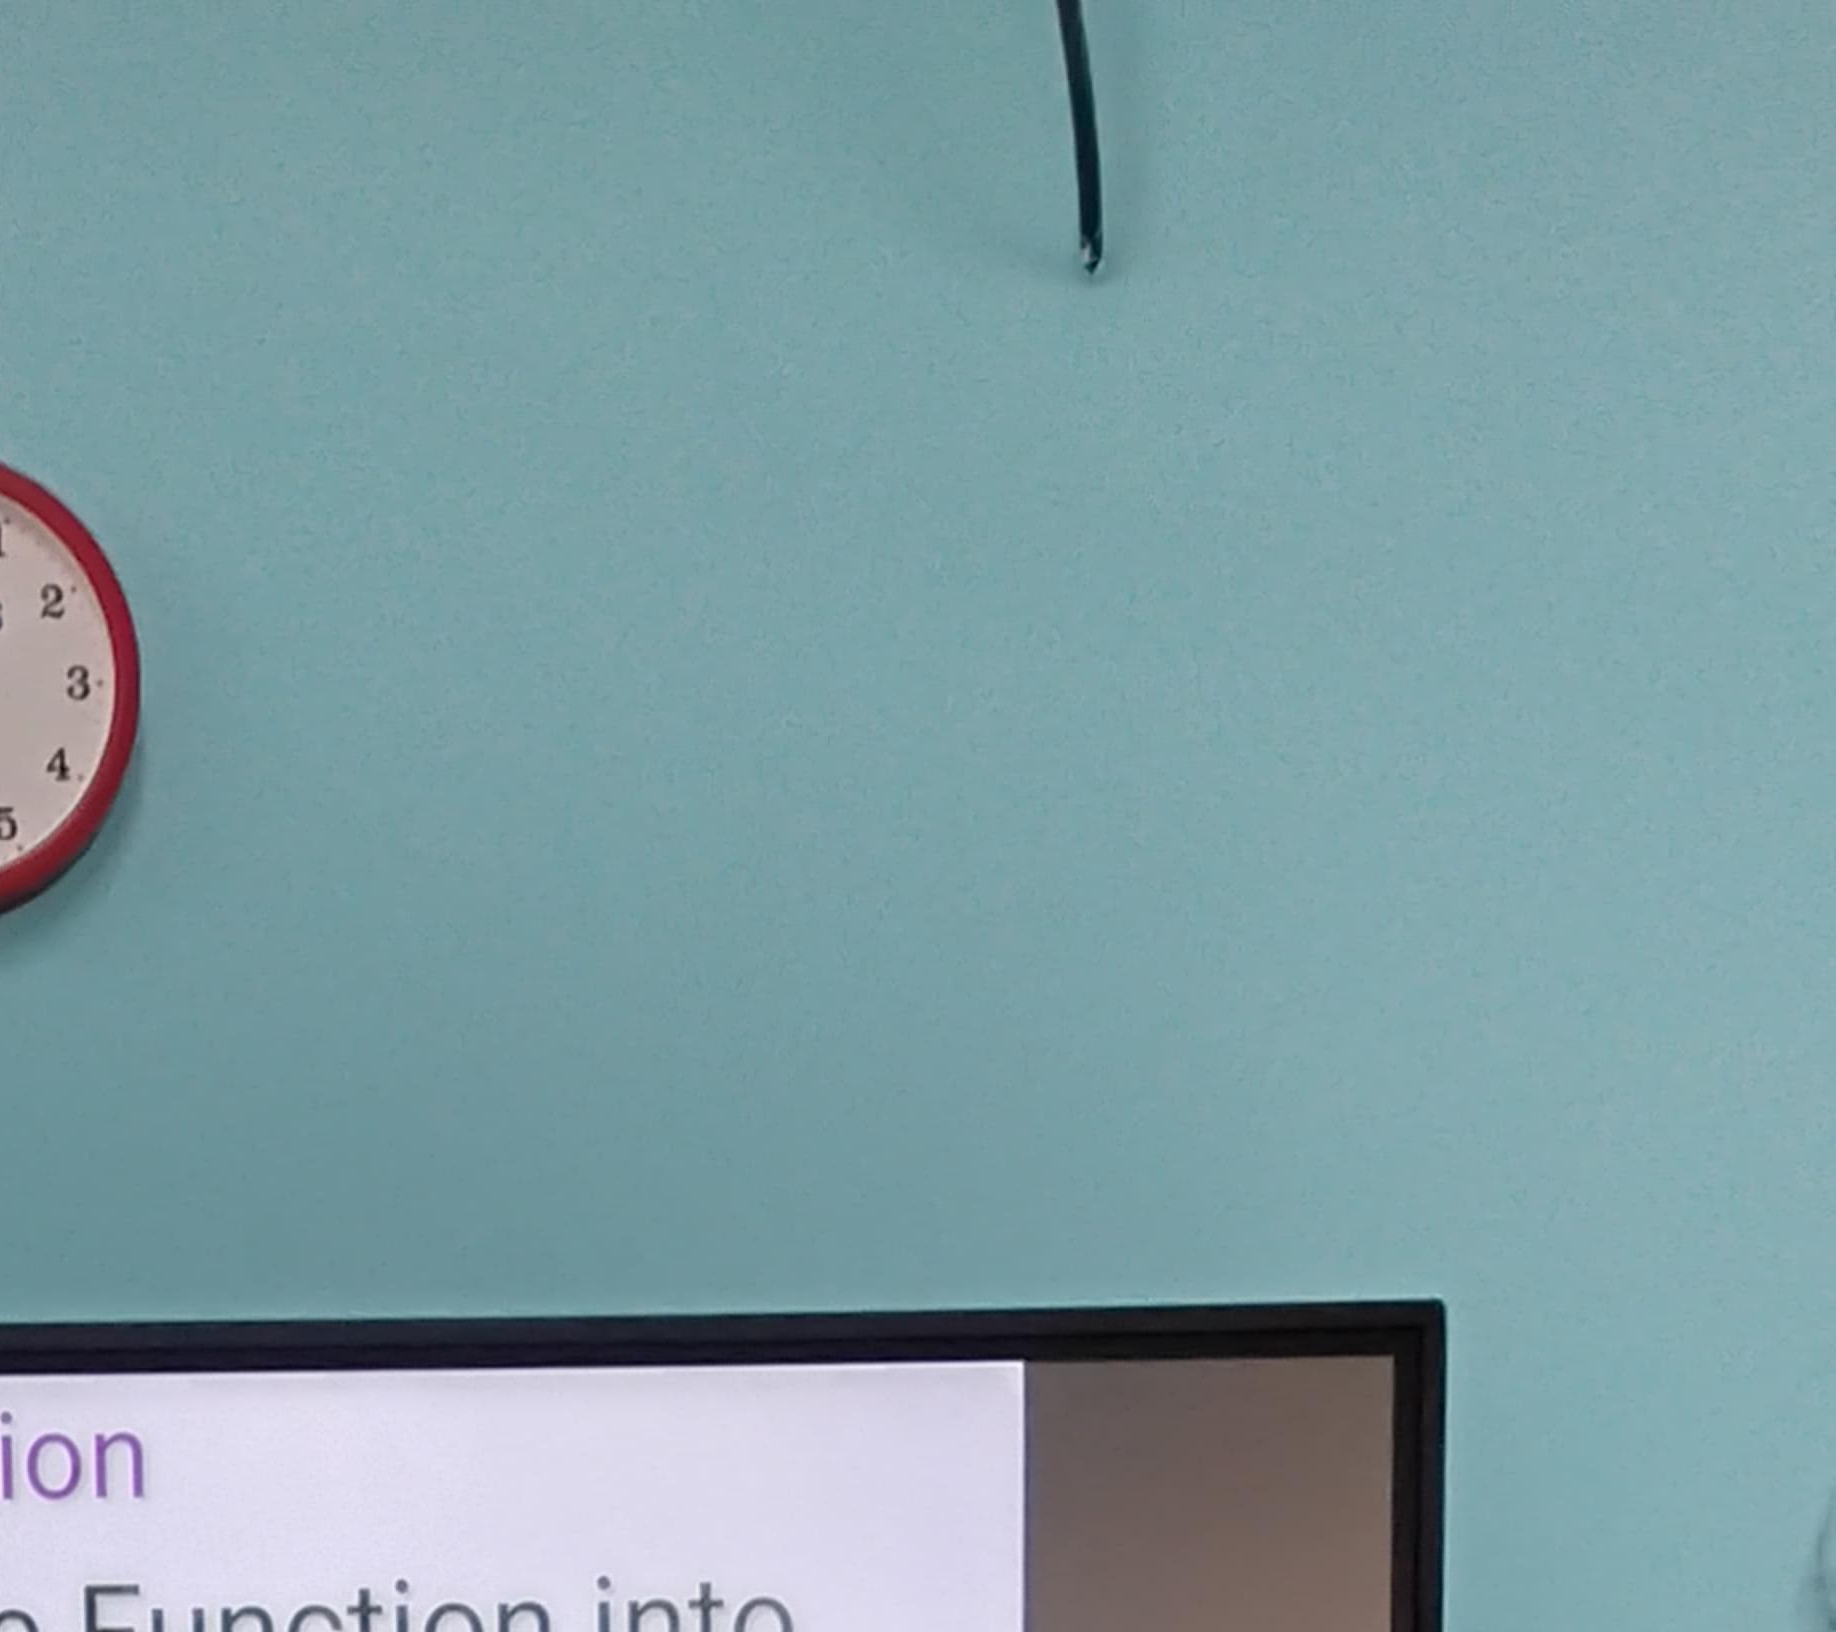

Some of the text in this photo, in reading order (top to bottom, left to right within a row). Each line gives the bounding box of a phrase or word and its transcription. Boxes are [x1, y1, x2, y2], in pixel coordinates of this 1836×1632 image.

[40, 583, 65, 619] 2
[67, 666, 91, 702] 3
[46, 748, 70, 782] 4
